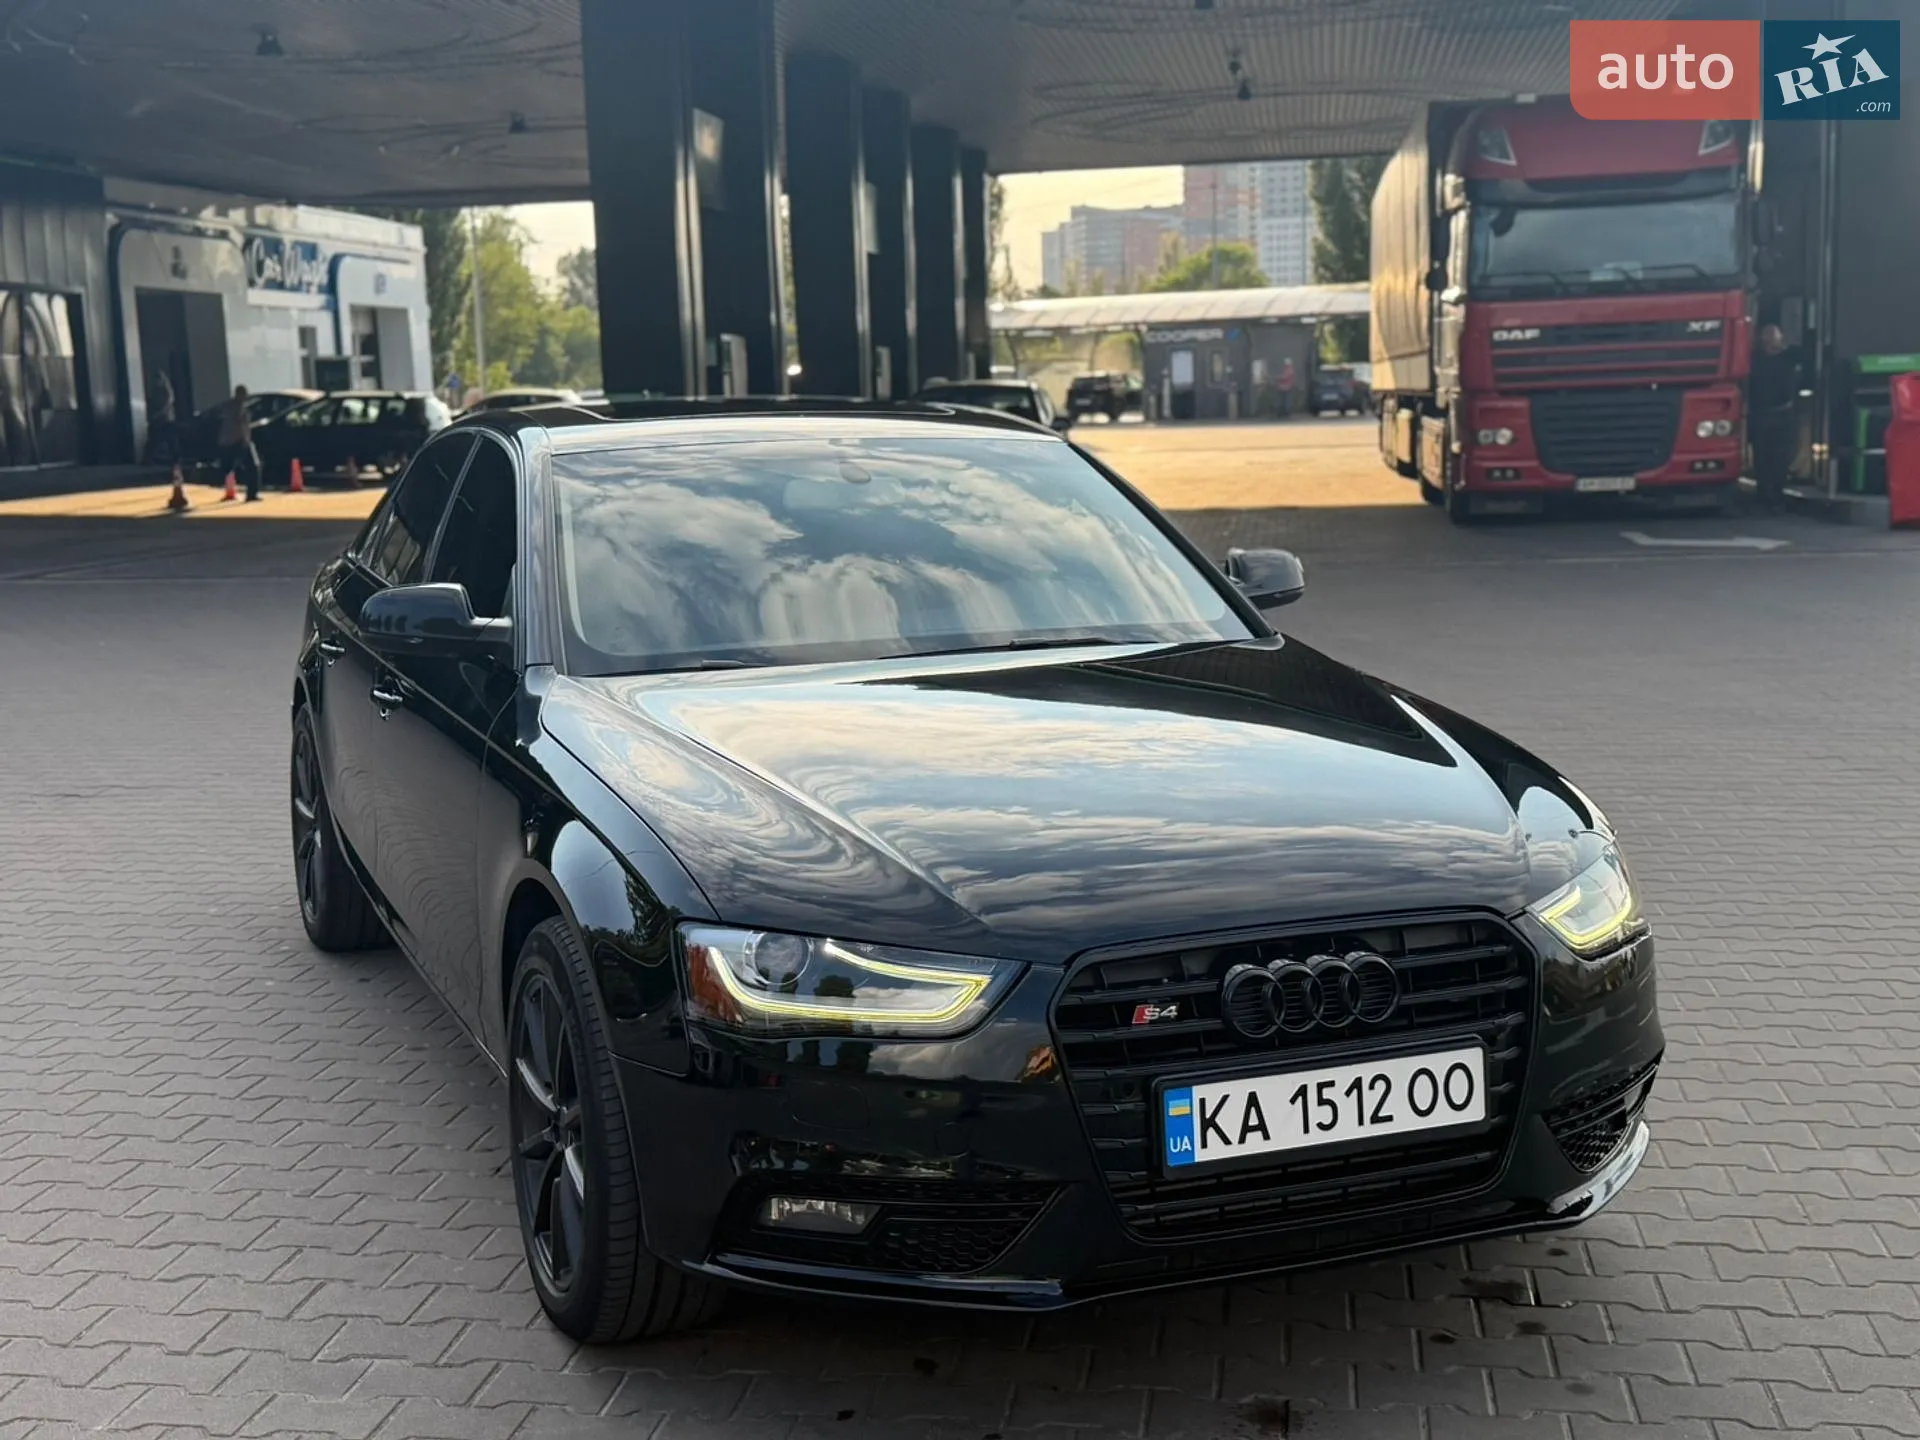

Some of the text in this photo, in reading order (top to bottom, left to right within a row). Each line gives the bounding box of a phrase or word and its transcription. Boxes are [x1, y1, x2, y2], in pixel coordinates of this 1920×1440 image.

[1687, 320, 1721, 332] XF
[1492, 328, 1541, 341] DAF
[1142, 1005, 1178, 1019] S4
[1199, 1091, 1271, 1149] KA
[1289, 1073, 1394, 1135] 1512
[1170, 1135, 1192, 1154] UA
